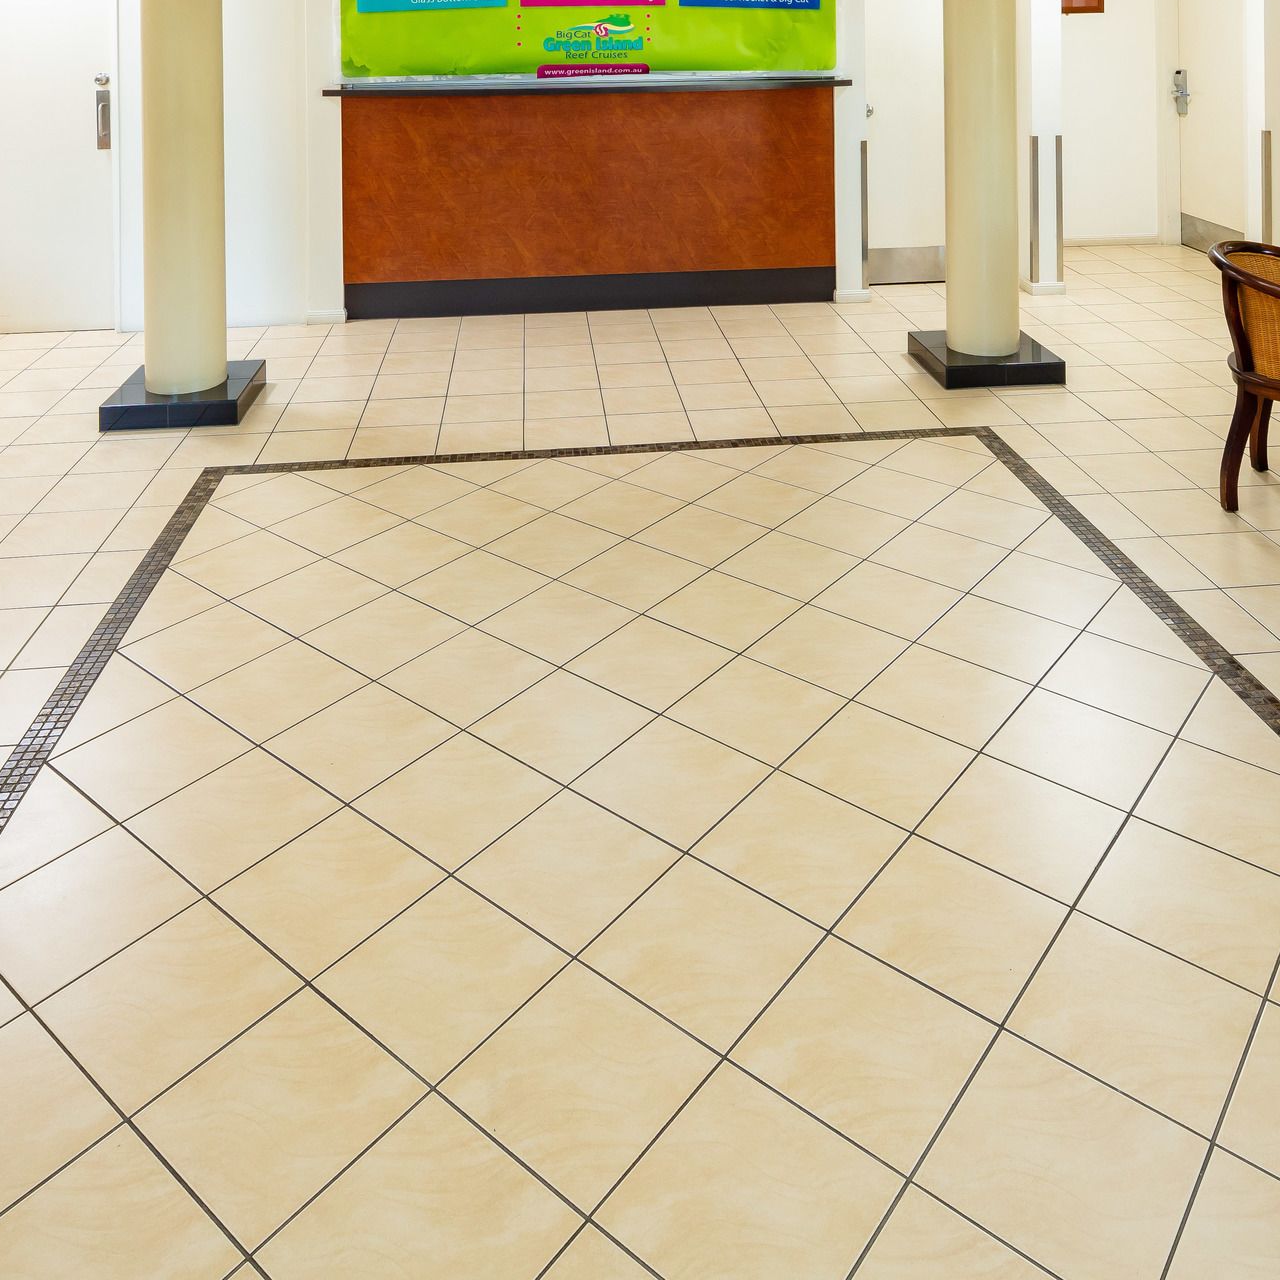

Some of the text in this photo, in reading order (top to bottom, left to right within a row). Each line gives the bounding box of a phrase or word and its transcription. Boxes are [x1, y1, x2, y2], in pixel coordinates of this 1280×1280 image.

[556, 30, 591, 40] Big Cat
[543, 36, 644, 52] Green Island
[565, 51, 628, 59] Reef Cruises
[544, 67, 642, 76] www.greenisland.com.au
